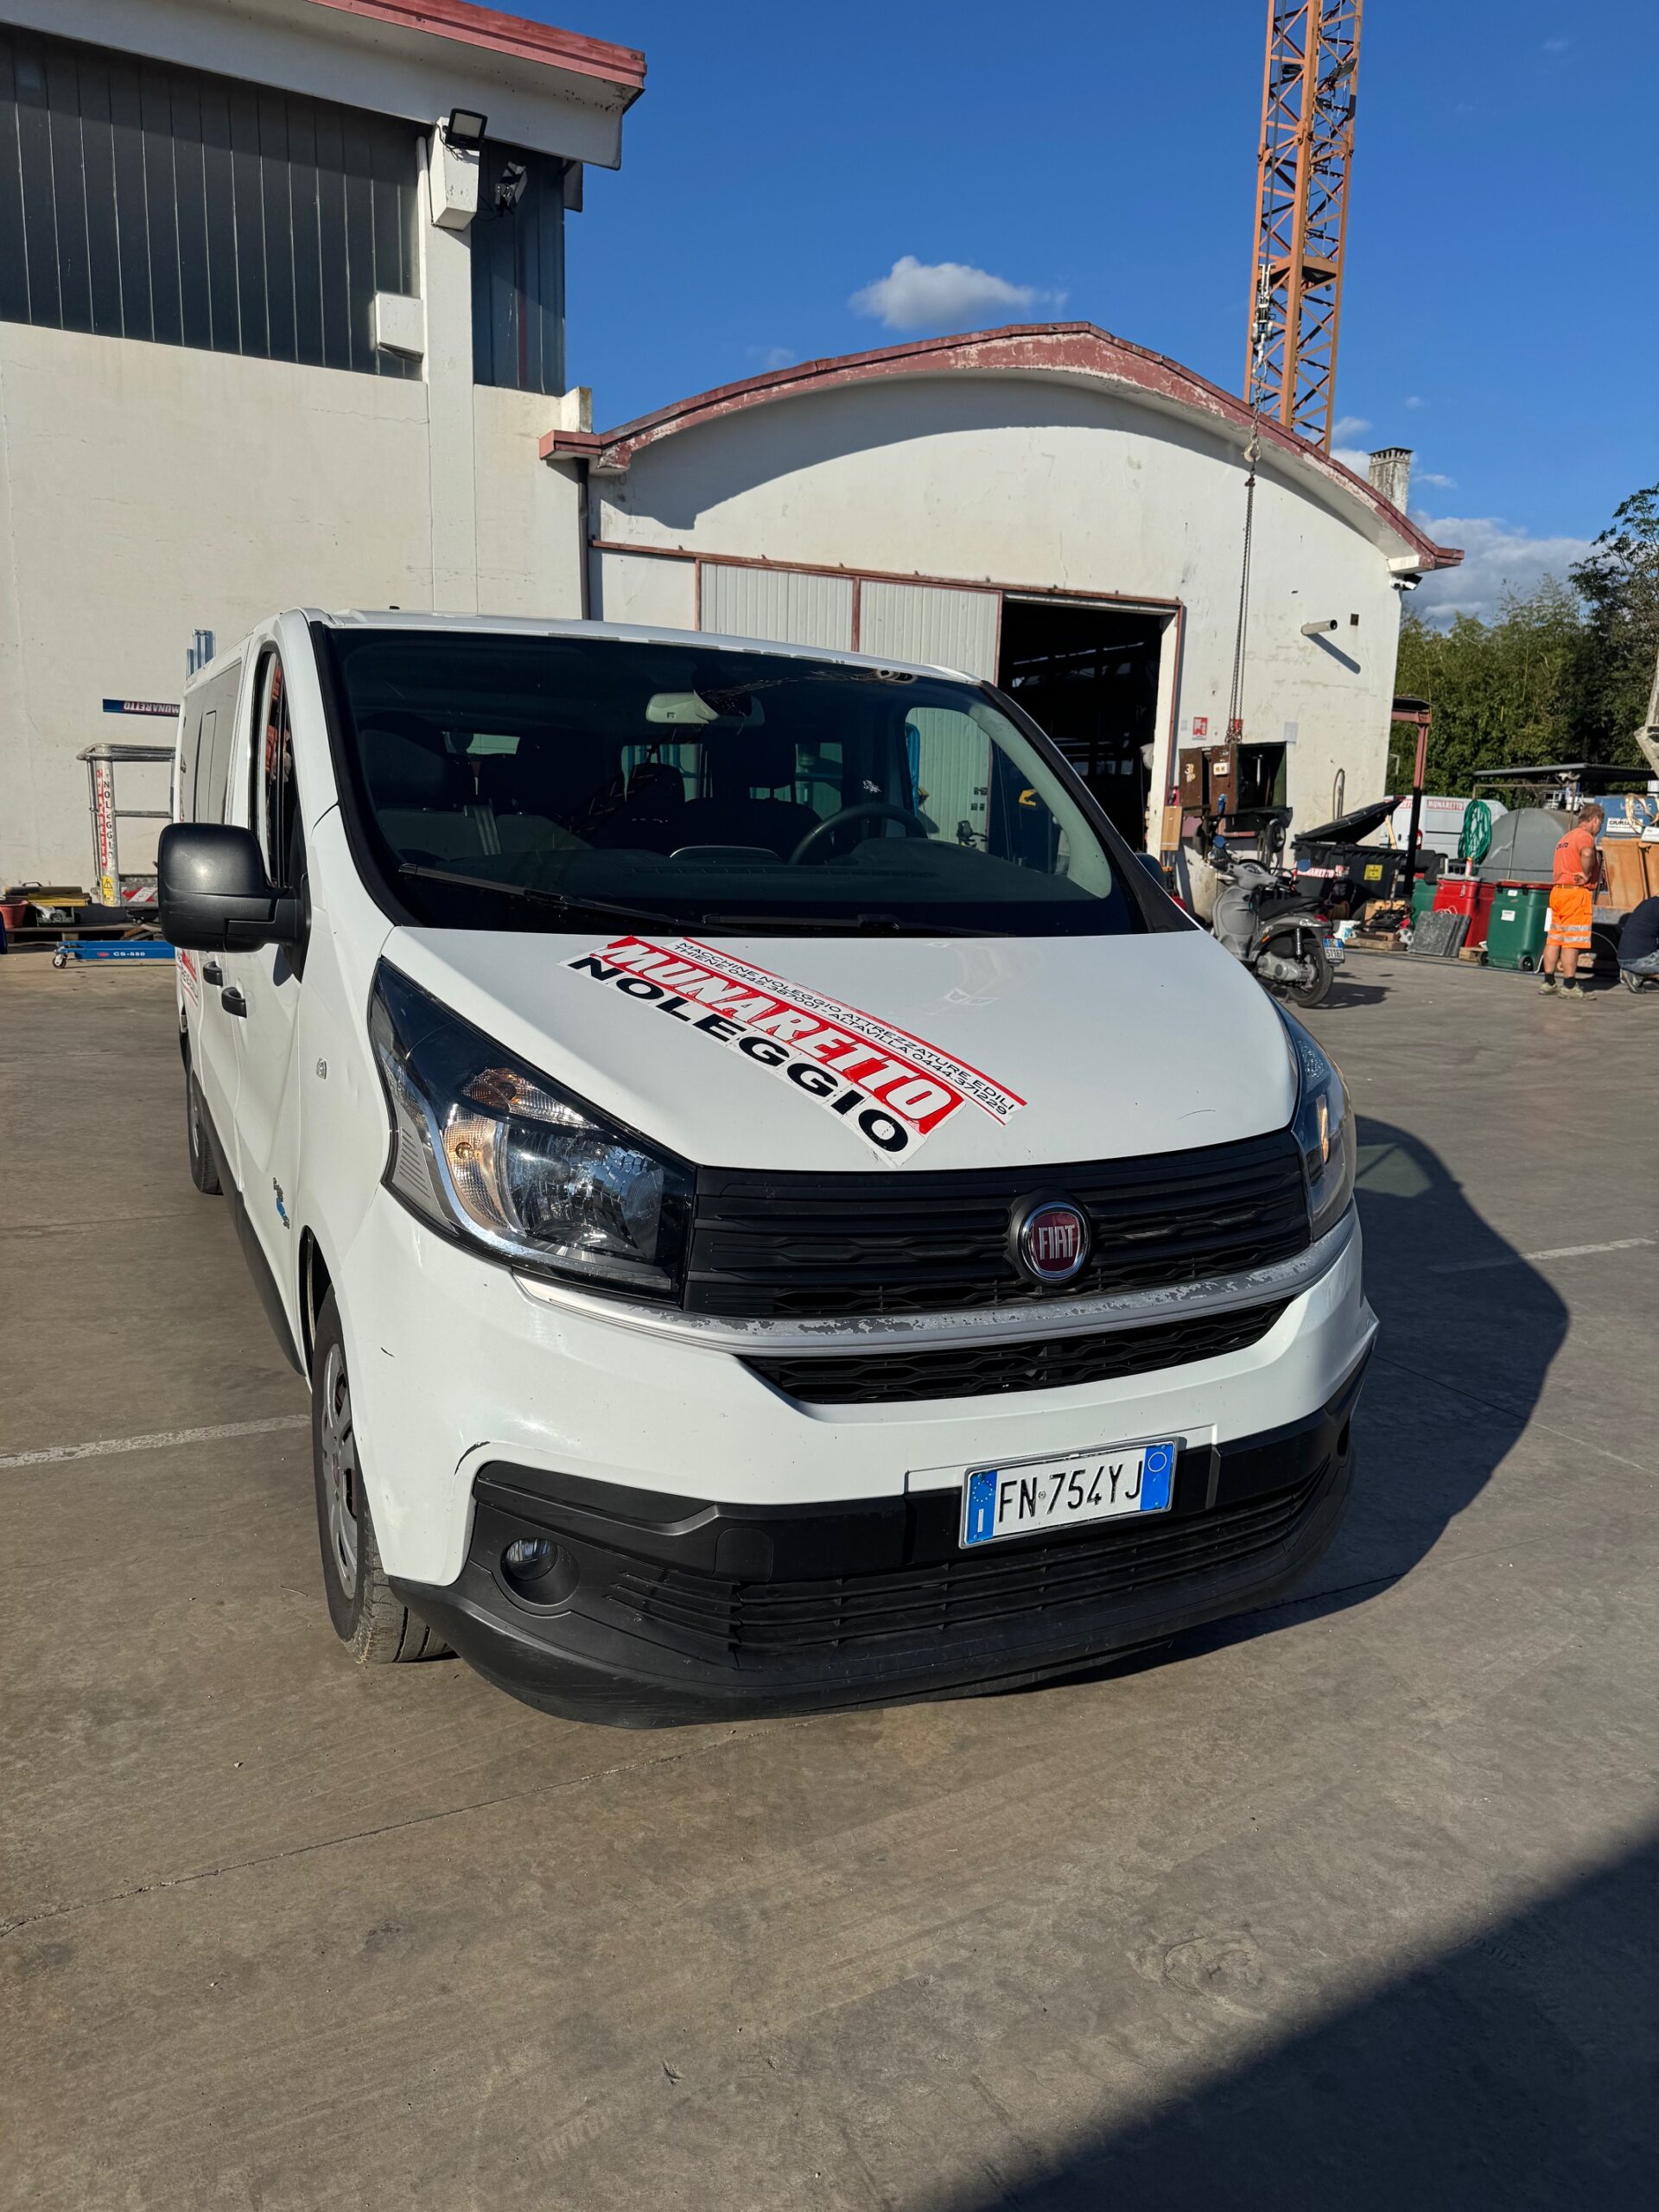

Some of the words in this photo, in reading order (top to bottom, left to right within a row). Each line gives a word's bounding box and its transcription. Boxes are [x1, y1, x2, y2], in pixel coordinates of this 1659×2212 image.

[567, 957, 909, 1153] NOLEGGIO
[594, 943, 952, 1120] MUNARETTO
[674, 944, 728, 969] THIENE
[728, 969, 820, 1009] 0445.387001
[828, 1013, 908, 1054] ALTAVILLA
[912, 1053, 1007, 1116] 0444.371229
[679, 942, 760, 977] MACCHINE
[760, 976, 842, 1013] NOLEGGIO
[842, 1013, 971, 1081] ATTREZZATURE
[972, 1079, 1015, 1110] EDILI
[1038, 1224, 1076, 1261] FIAT
